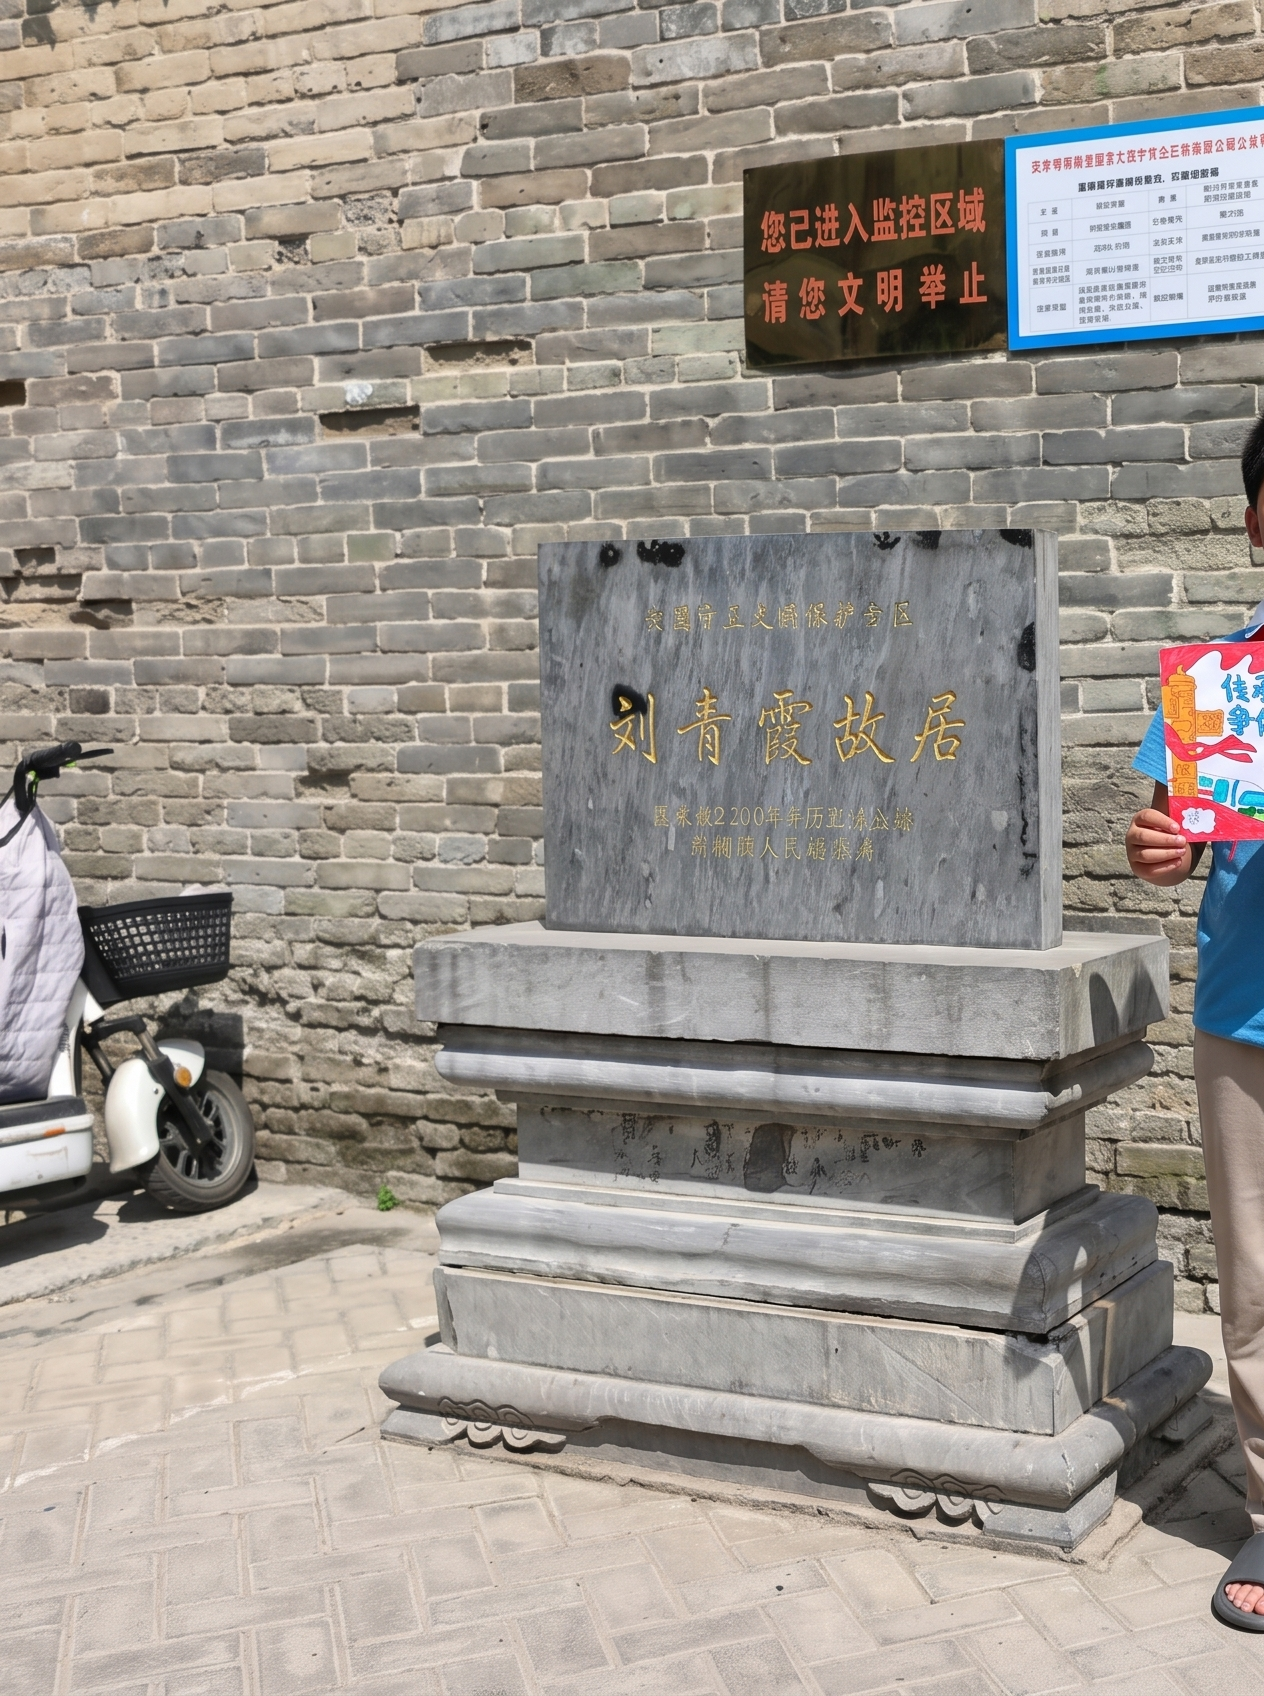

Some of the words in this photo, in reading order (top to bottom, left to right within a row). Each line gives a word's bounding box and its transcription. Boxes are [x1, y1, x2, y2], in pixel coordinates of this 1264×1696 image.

[760, 187, 986, 254] 您已进入监控区域
[761, 261, 988, 324] 请您文明举止
[609, 687, 966, 766] 刘青霞故居
